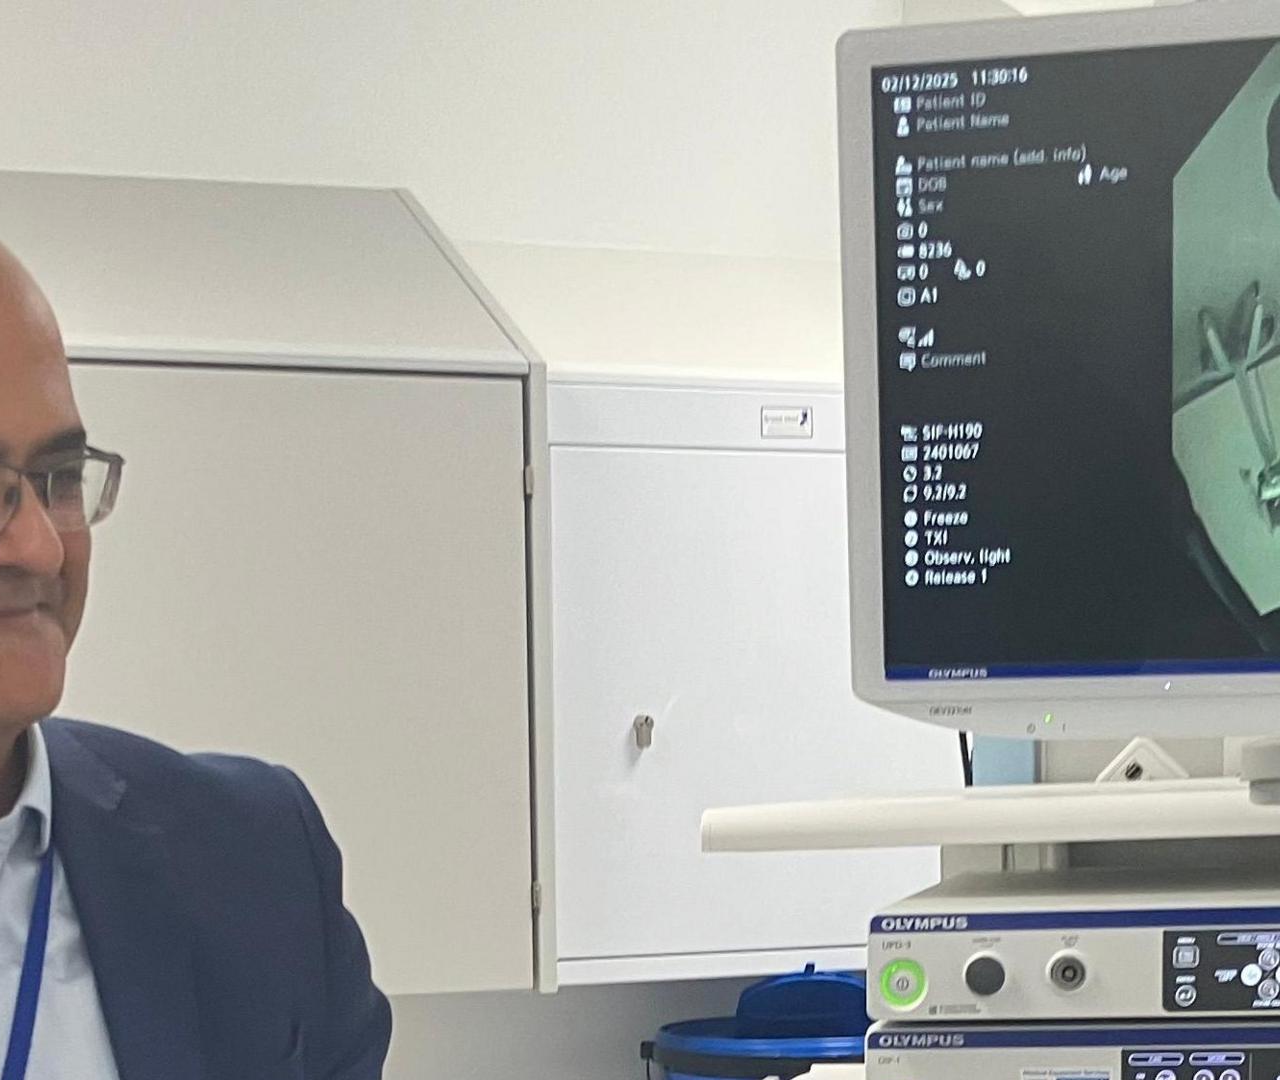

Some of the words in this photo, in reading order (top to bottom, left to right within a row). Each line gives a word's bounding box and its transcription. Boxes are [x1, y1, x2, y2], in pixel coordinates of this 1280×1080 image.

[881, 72, 958, 93] 02/12/2025
[972, 66, 1027, 86] 11:30:16
[916, 93, 964, 111] Patient
[971, 92, 986, 108] ID
[916, 115, 964, 132] Patient
[970, 113, 1010, 128] Name
[918, 154, 965, 171] Patient
[971, 153, 1009, 167] name
[1099, 165, 1128, 184] Age
[918, 177, 947, 193] DOB
[919, 199, 944, 215] Sex
[921, 351, 986, 369] Comment
[922, 421, 983, 441] SIF-H190
[924, 510, 968, 526] Freeze
[924, 529, 948, 546] TXI
[979, 548, 1011, 567] light
[924, 569, 976, 586] Release
[928, 667, 988, 679] OLYMPUS
[881, 916, 968, 931] OLYMPUS
[878, 1033, 965, 1048] OLYMPUS
